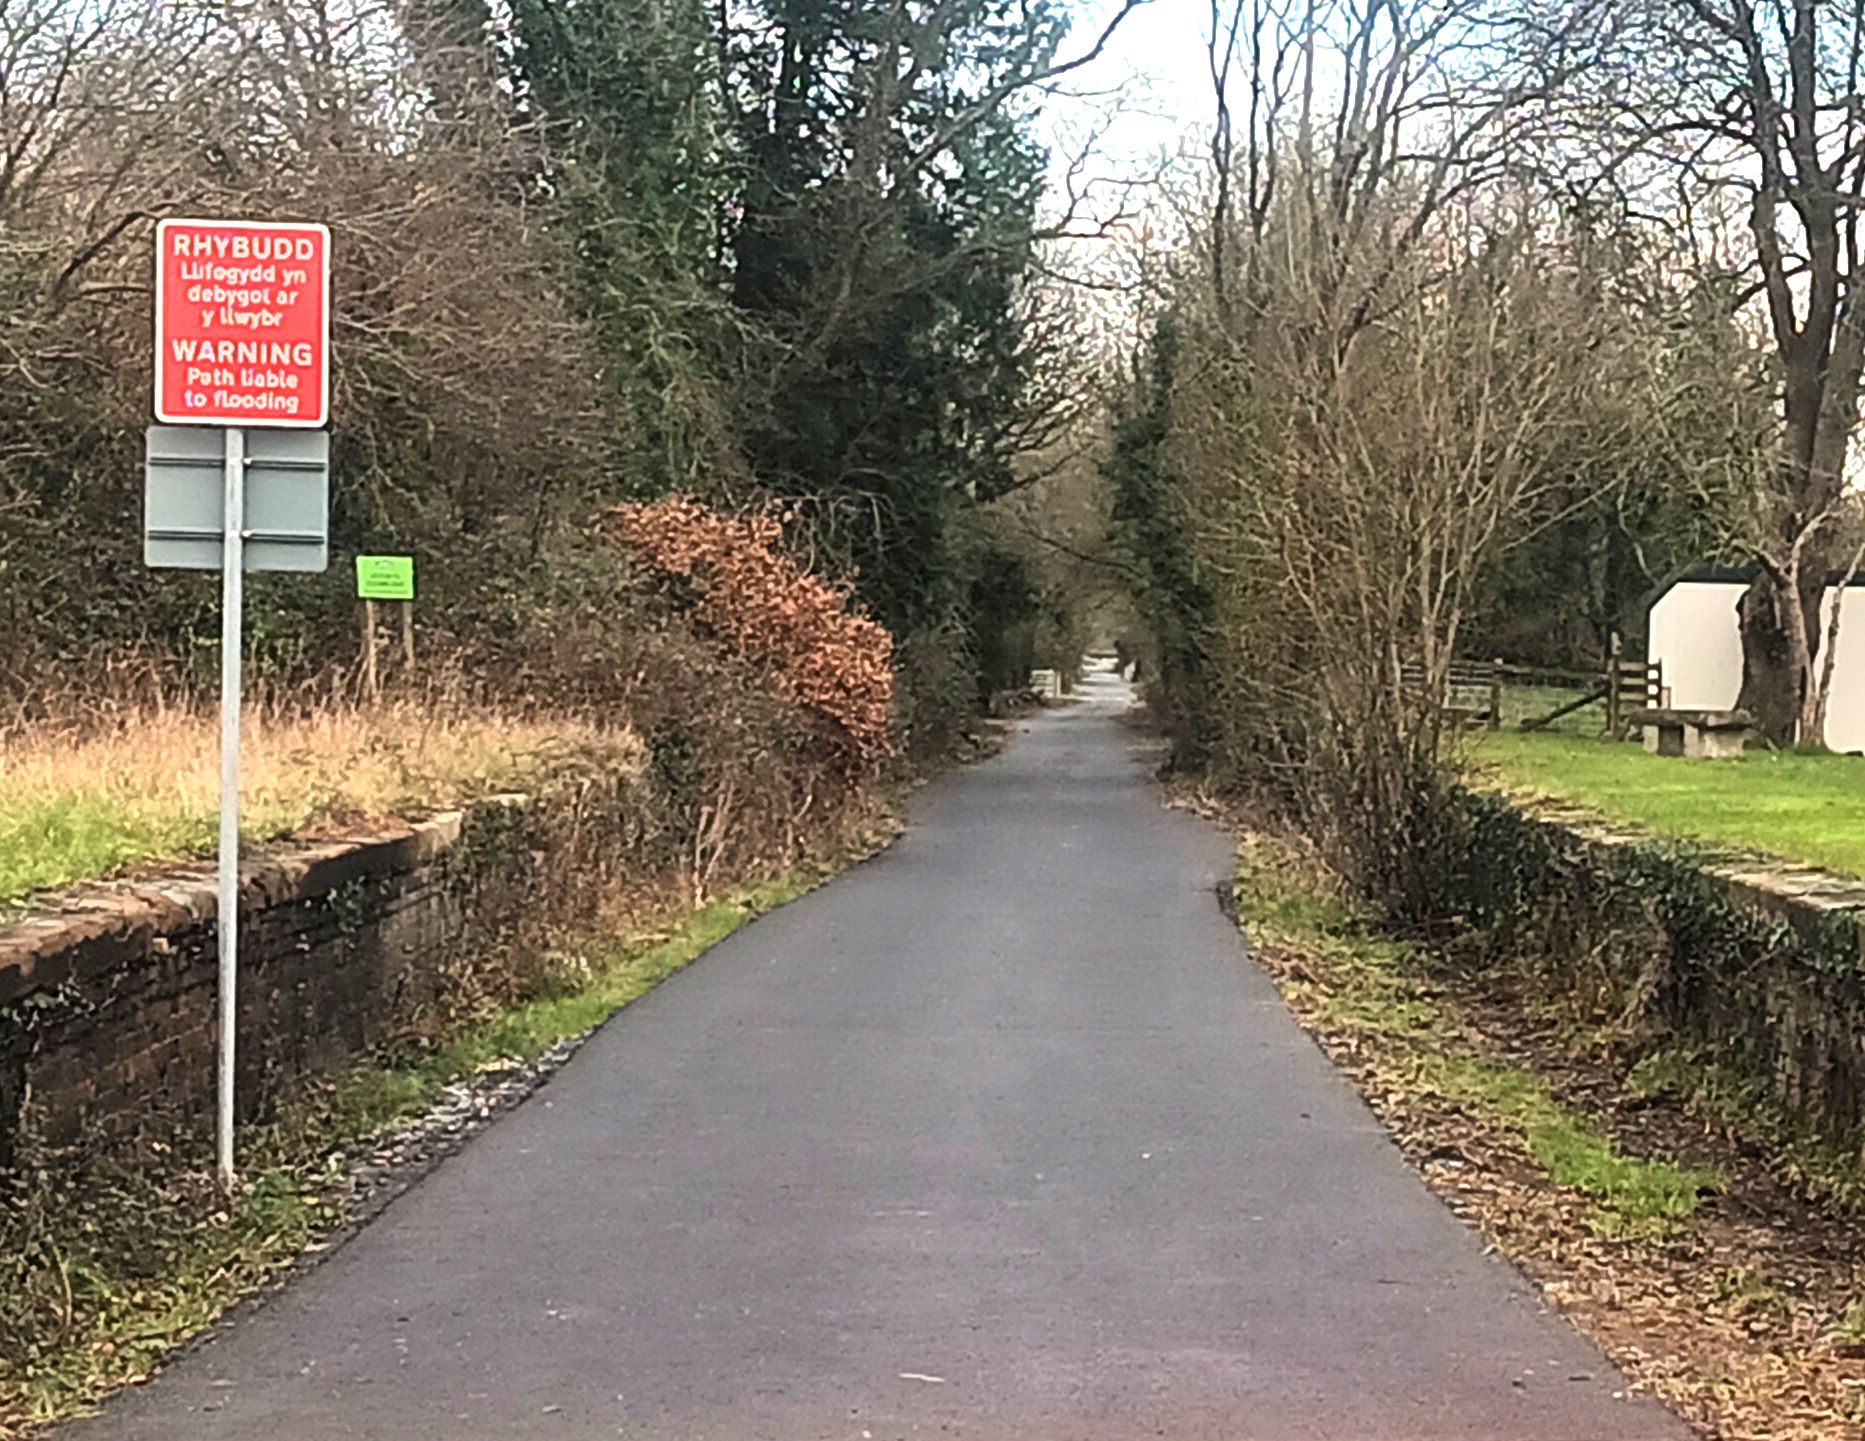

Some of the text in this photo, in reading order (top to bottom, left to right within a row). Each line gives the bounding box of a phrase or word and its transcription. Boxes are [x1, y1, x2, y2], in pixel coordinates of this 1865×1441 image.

[173, 234, 314, 260] RHYBUDD
[181, 261, 306, 286] Llifogydd yn
[188, 285, 298, 307] debygol ar
[202, 307, 283, 329] y llwybr
[172, 339, 312, 366] WARNING
[187, 367, 297, 388] Path liable
[185, 390, 299, 413] to flooding
